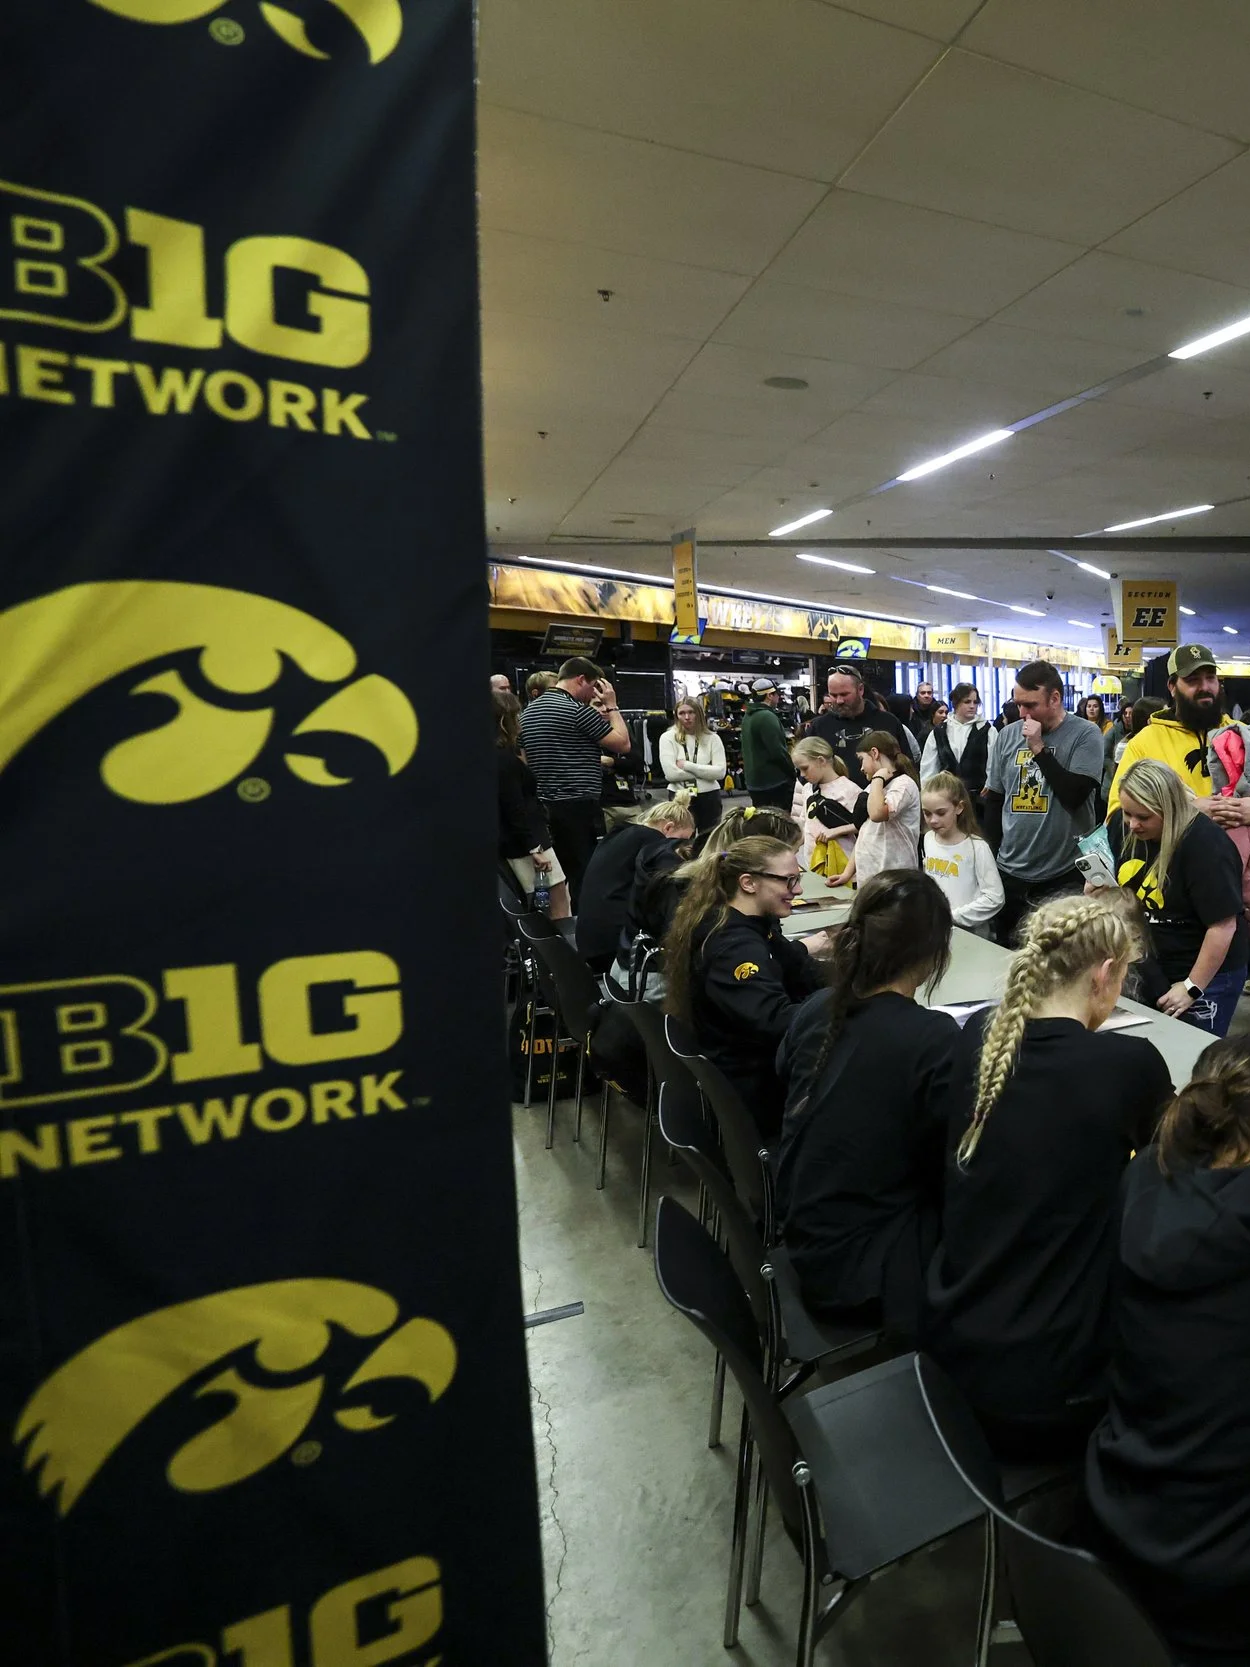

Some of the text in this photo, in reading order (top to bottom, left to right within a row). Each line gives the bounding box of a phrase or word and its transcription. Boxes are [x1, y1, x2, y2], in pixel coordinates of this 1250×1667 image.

[0, 341, 372, 440] ETWORK
[936, 637, 956, 645] MEN
[1132, 607, 1168, 628] EE
[0, 1071, 408, 1177] NETWORK
